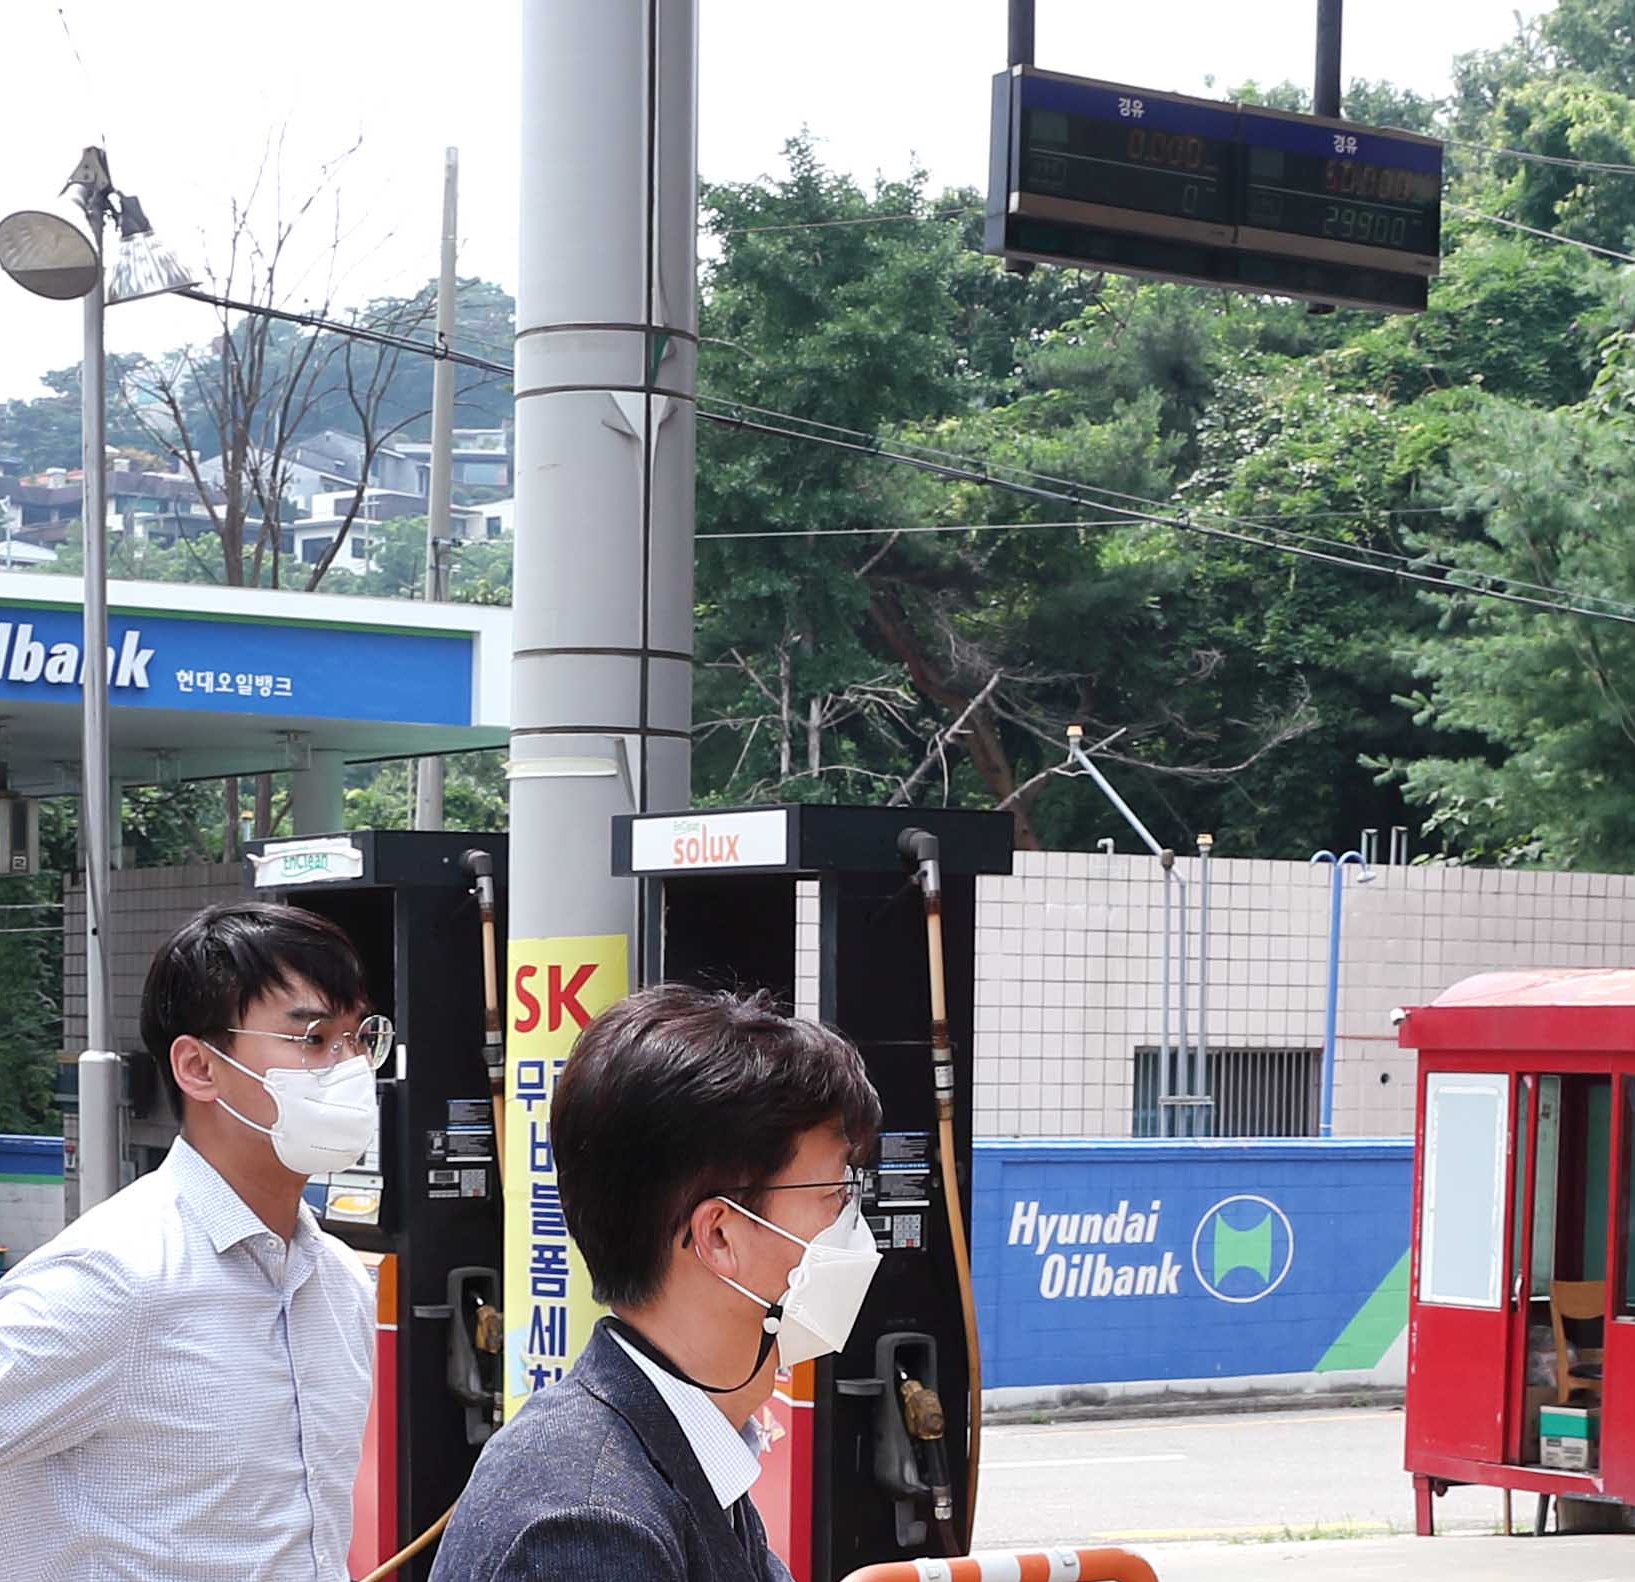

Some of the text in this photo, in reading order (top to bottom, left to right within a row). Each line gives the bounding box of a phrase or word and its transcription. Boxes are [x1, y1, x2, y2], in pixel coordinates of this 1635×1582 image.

[1117, 97, 1145, 119] 경유
[1333, 133, 1359, 155] 경유
[175, 669, 294, 697] 현대오일뱅크
[673, 823, 740, 865] solux
[514, 964, 600, 1034] SK
[1008, 1200, 1162, 1255] Hyundai
[1040, 1251, 1183, 1300] Oilbank
